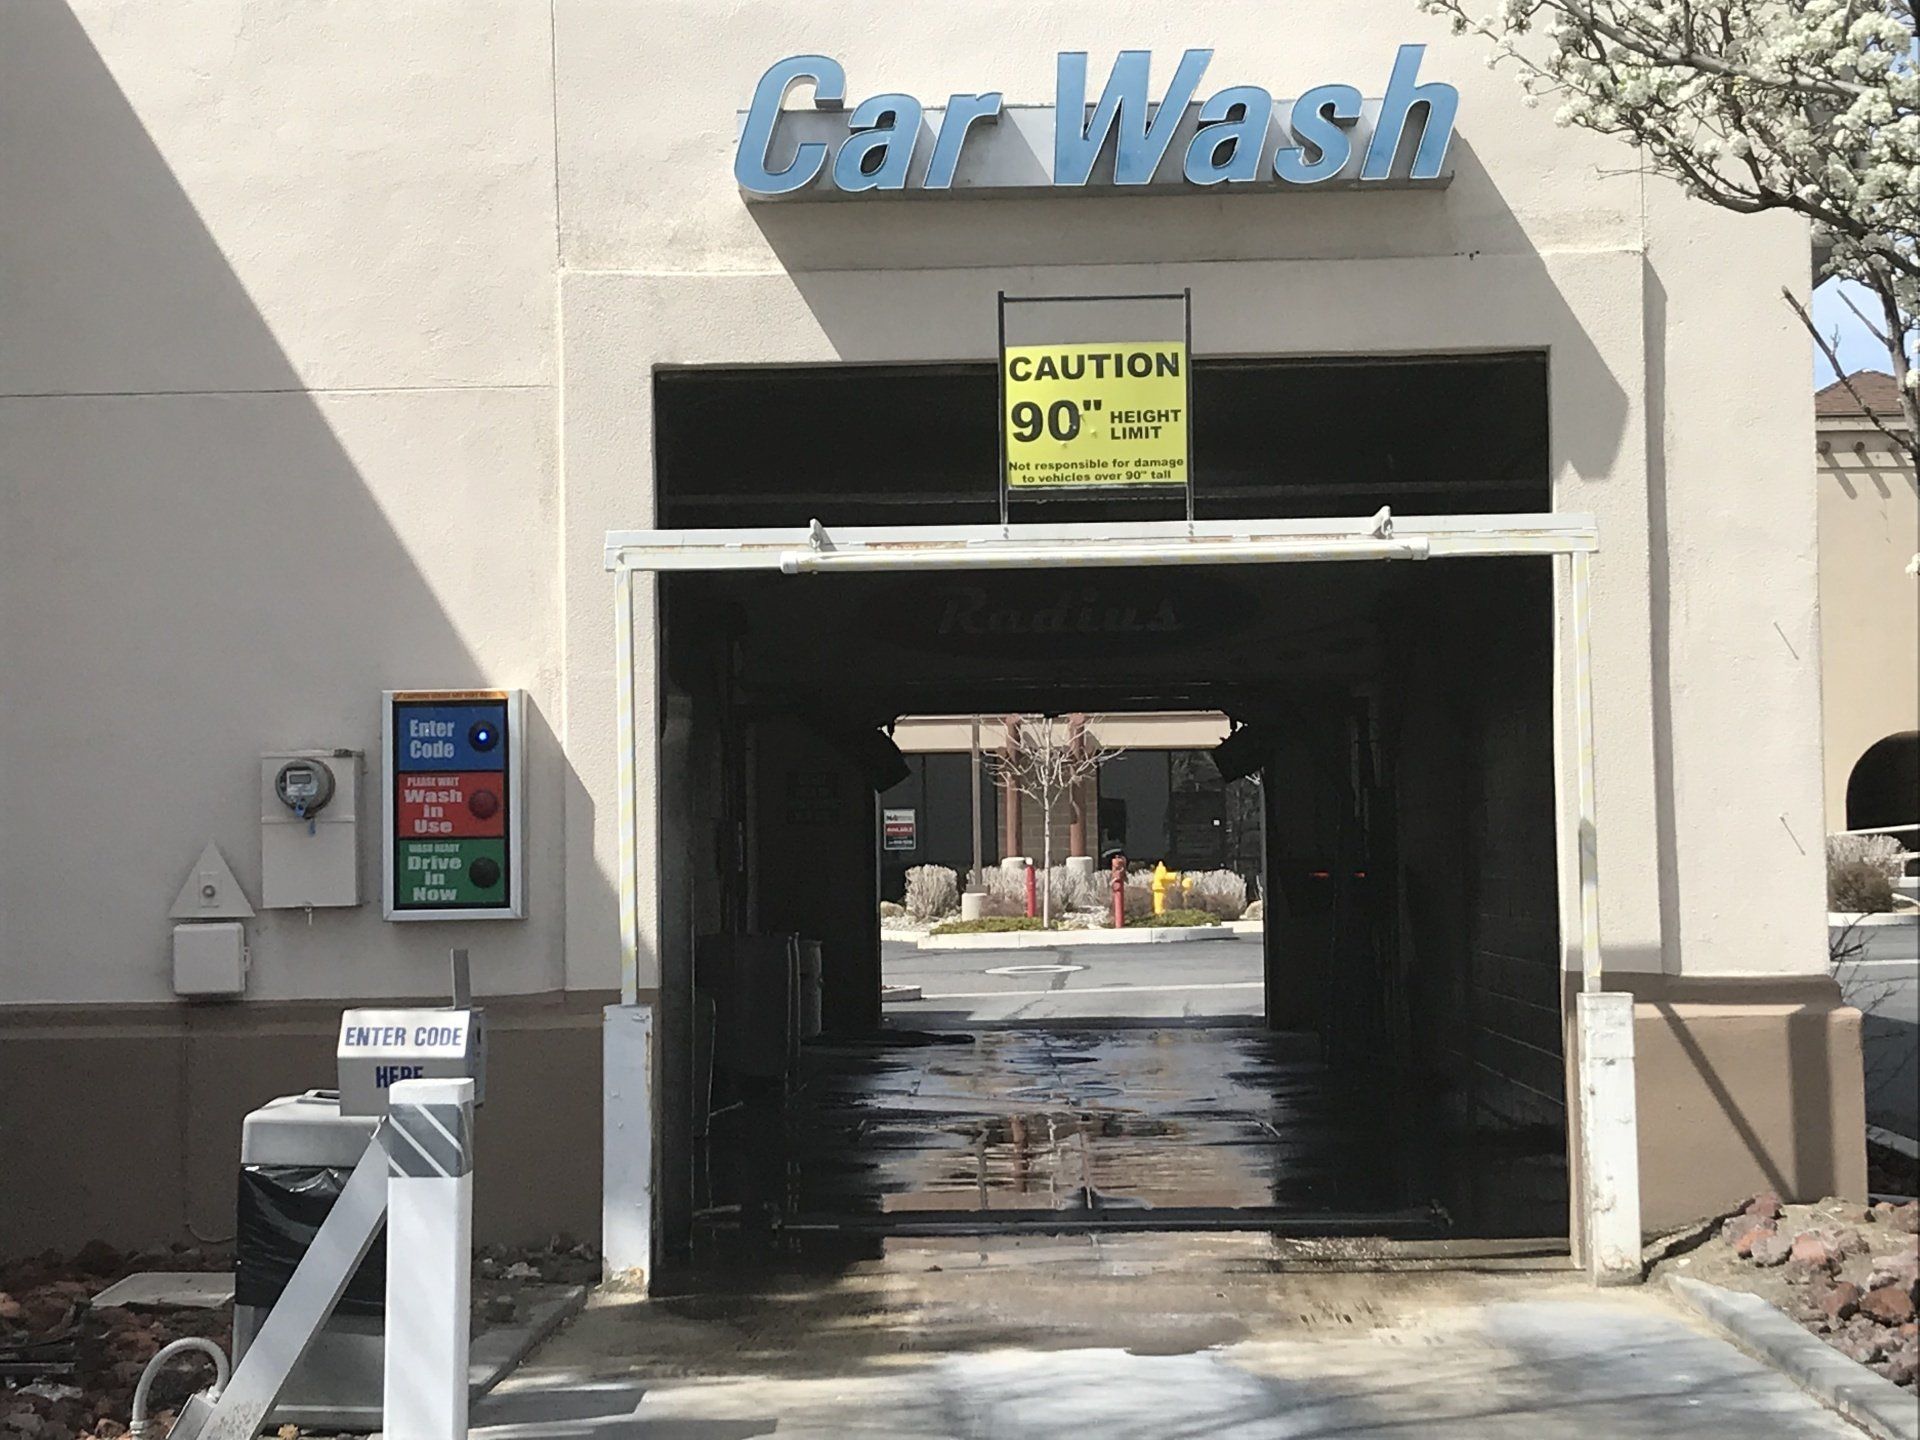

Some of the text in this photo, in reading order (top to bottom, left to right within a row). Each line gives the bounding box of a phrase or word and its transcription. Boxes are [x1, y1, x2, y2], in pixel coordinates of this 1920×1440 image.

[734, 44, 1459, 193] Car Wash
[1009, 352, 1179, 381] CAUTION
[1011, 400, 1102, 442] 90"
[1110, 409, 1181, 423] HEIGHT
[1110, 426, 1162, 440] LIMIT
[1009, 457, 1184, 471] Not responsible for damage
[1022, 470, 1171, 483] to vehicles over 90" tall
[409, 719, 455, 738] Enter
[410, 740, 455, 759] Code
[407, 777, 436, 787] PLEASE
[404, 789, 462, 803] Wash
[423, 804, 443, 818] in
[414, 819, 452, 833] Use
[407, 856, 462, 870] Drive
[425, 871, 445, 886] in
[412, 887, 457, 901] Now
[345, 1026, 463, 1046] ENTER CODE
